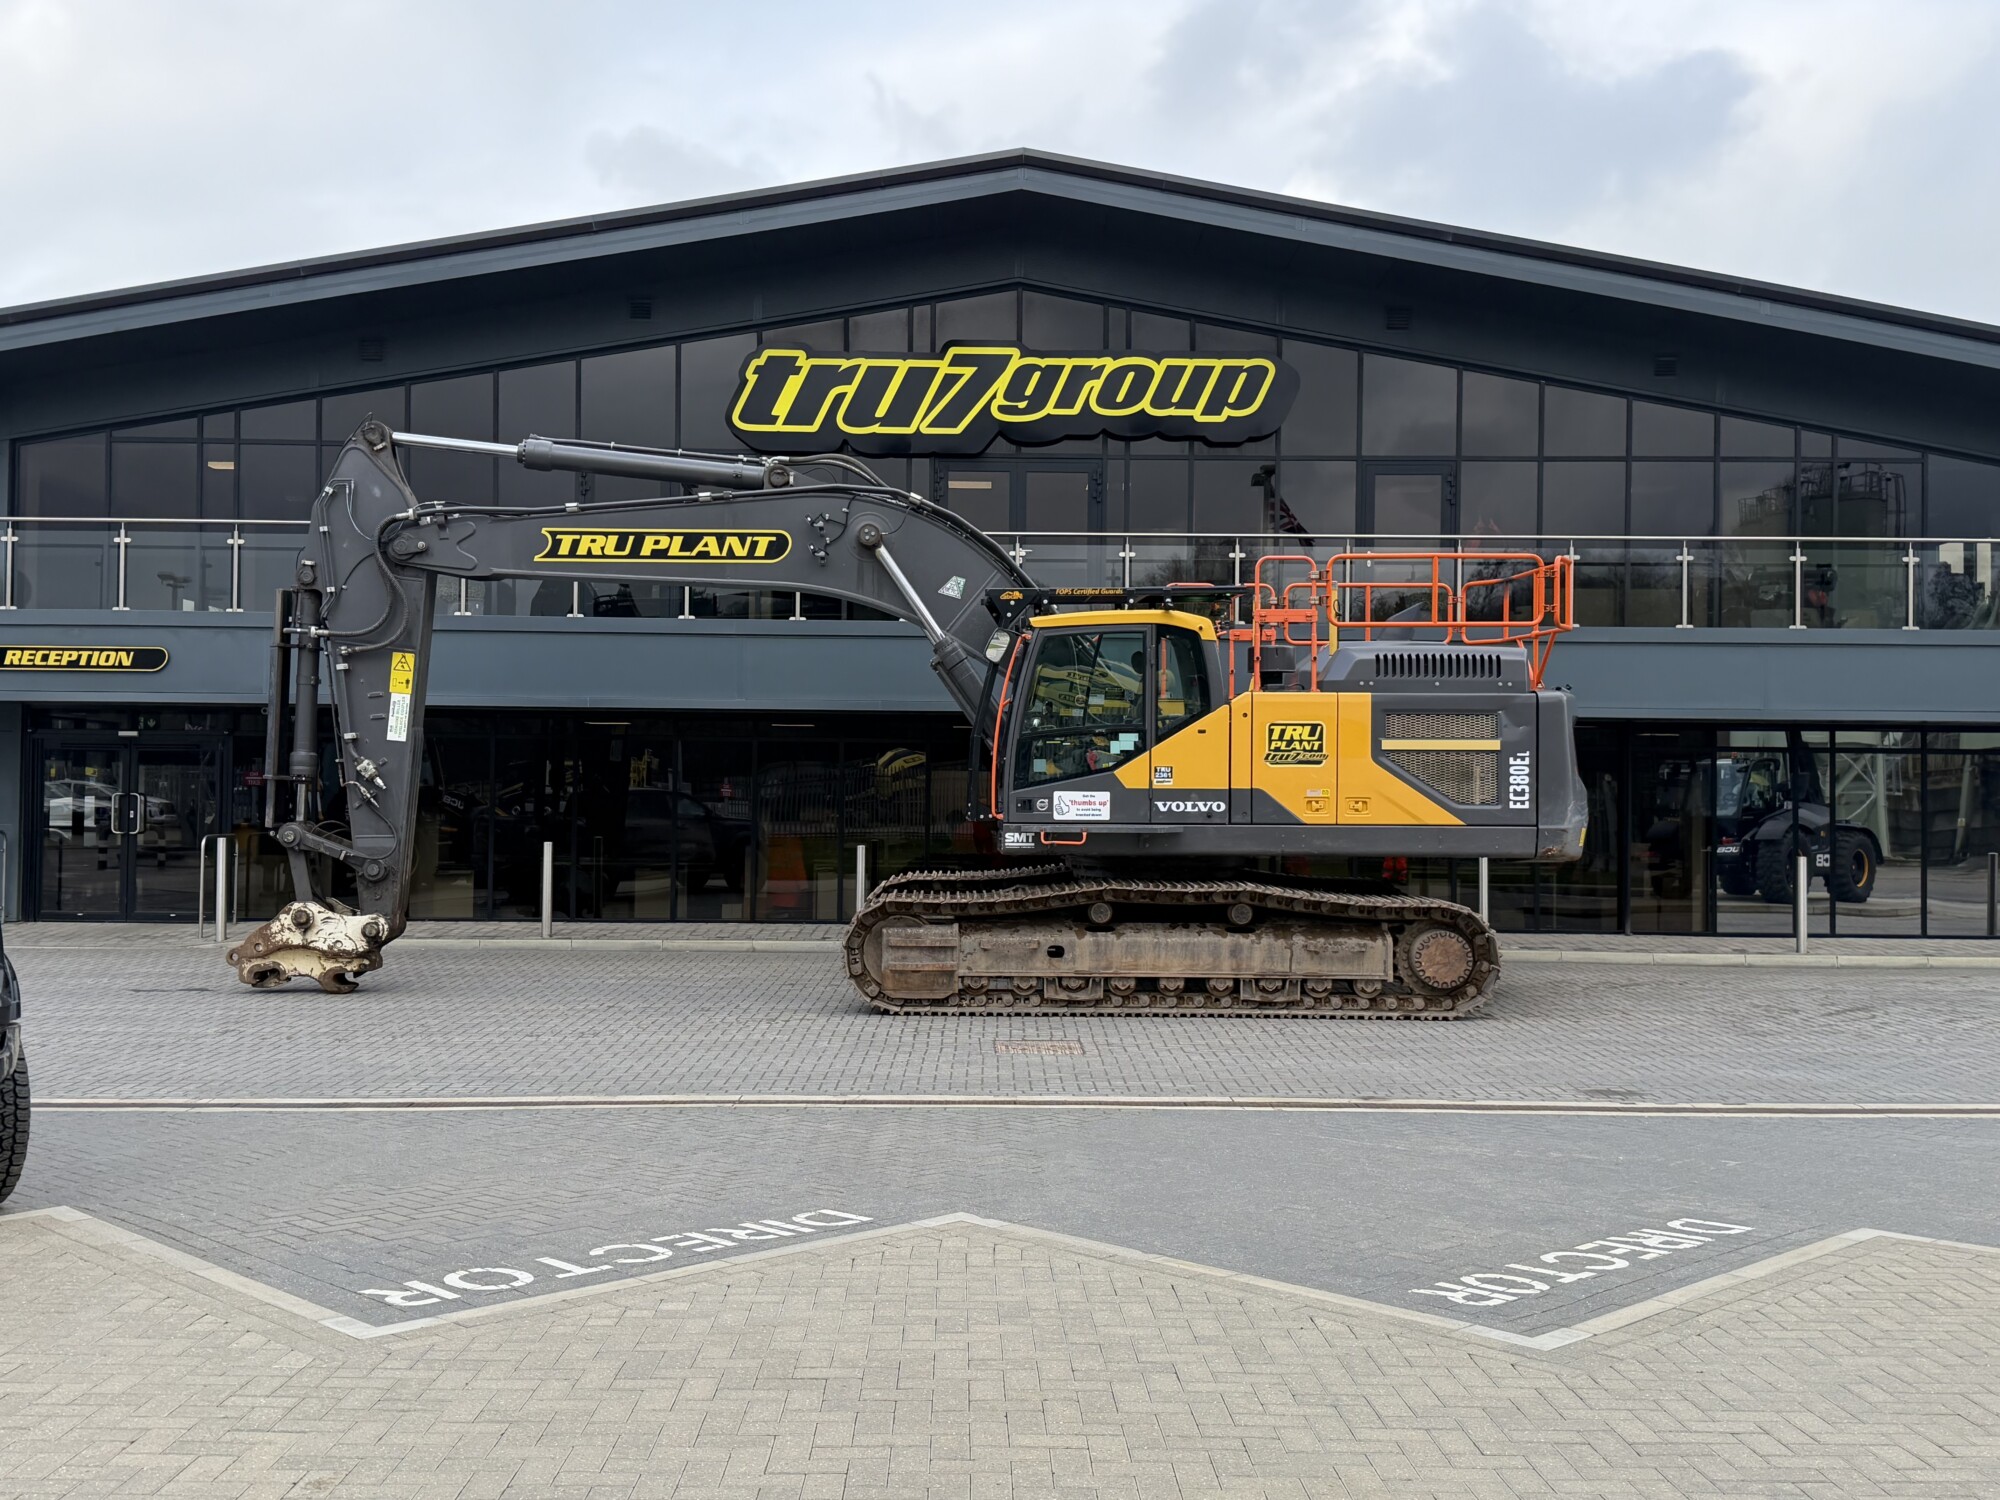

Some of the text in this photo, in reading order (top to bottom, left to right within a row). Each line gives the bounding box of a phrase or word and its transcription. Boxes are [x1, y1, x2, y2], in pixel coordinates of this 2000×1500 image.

[555, 534, 776, 557] TRU PLANT
[4, 650, 134, 666] RECEPTION
[1270, 726, 1322, 740] TRU
[1270, 741, 1322, 750] PLANT
[1154, 801, 1226, 812] VOLVO
[1005, 832, 1035, 842] SMT
[356, 1208, 873, 1307] DIRECTOR
[1408, 1217, 1755, 1306] DIRECTOR
